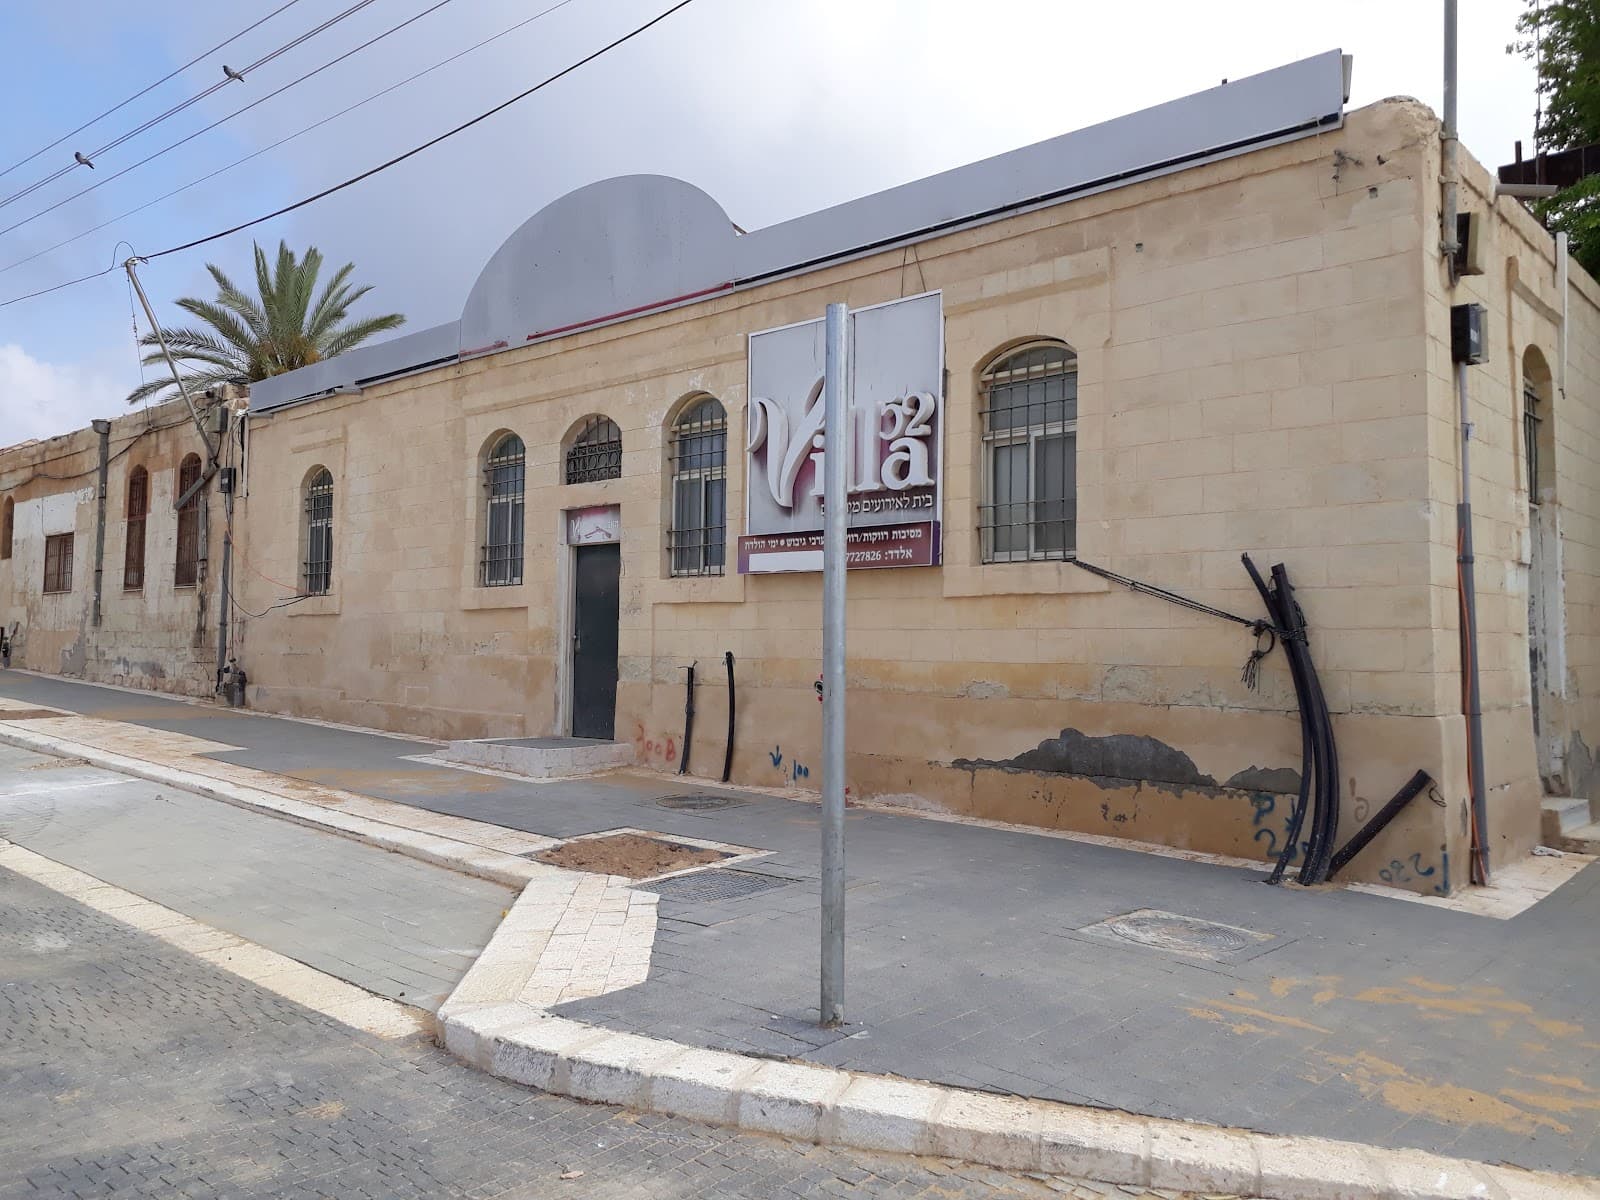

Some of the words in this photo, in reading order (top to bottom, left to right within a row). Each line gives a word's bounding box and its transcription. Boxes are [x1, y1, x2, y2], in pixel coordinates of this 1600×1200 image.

[862, 492, 911, 512] לאירועים
[911, 494, 933, 509] בית
[891, 528, 922, 540] מסיבות
[744, 538, 766, 550] הולדת
[768, 539, 779, 548] ימי
[786, 537, 807, 547] גיבוש
[885, 545, 912, 560] אלדד:
